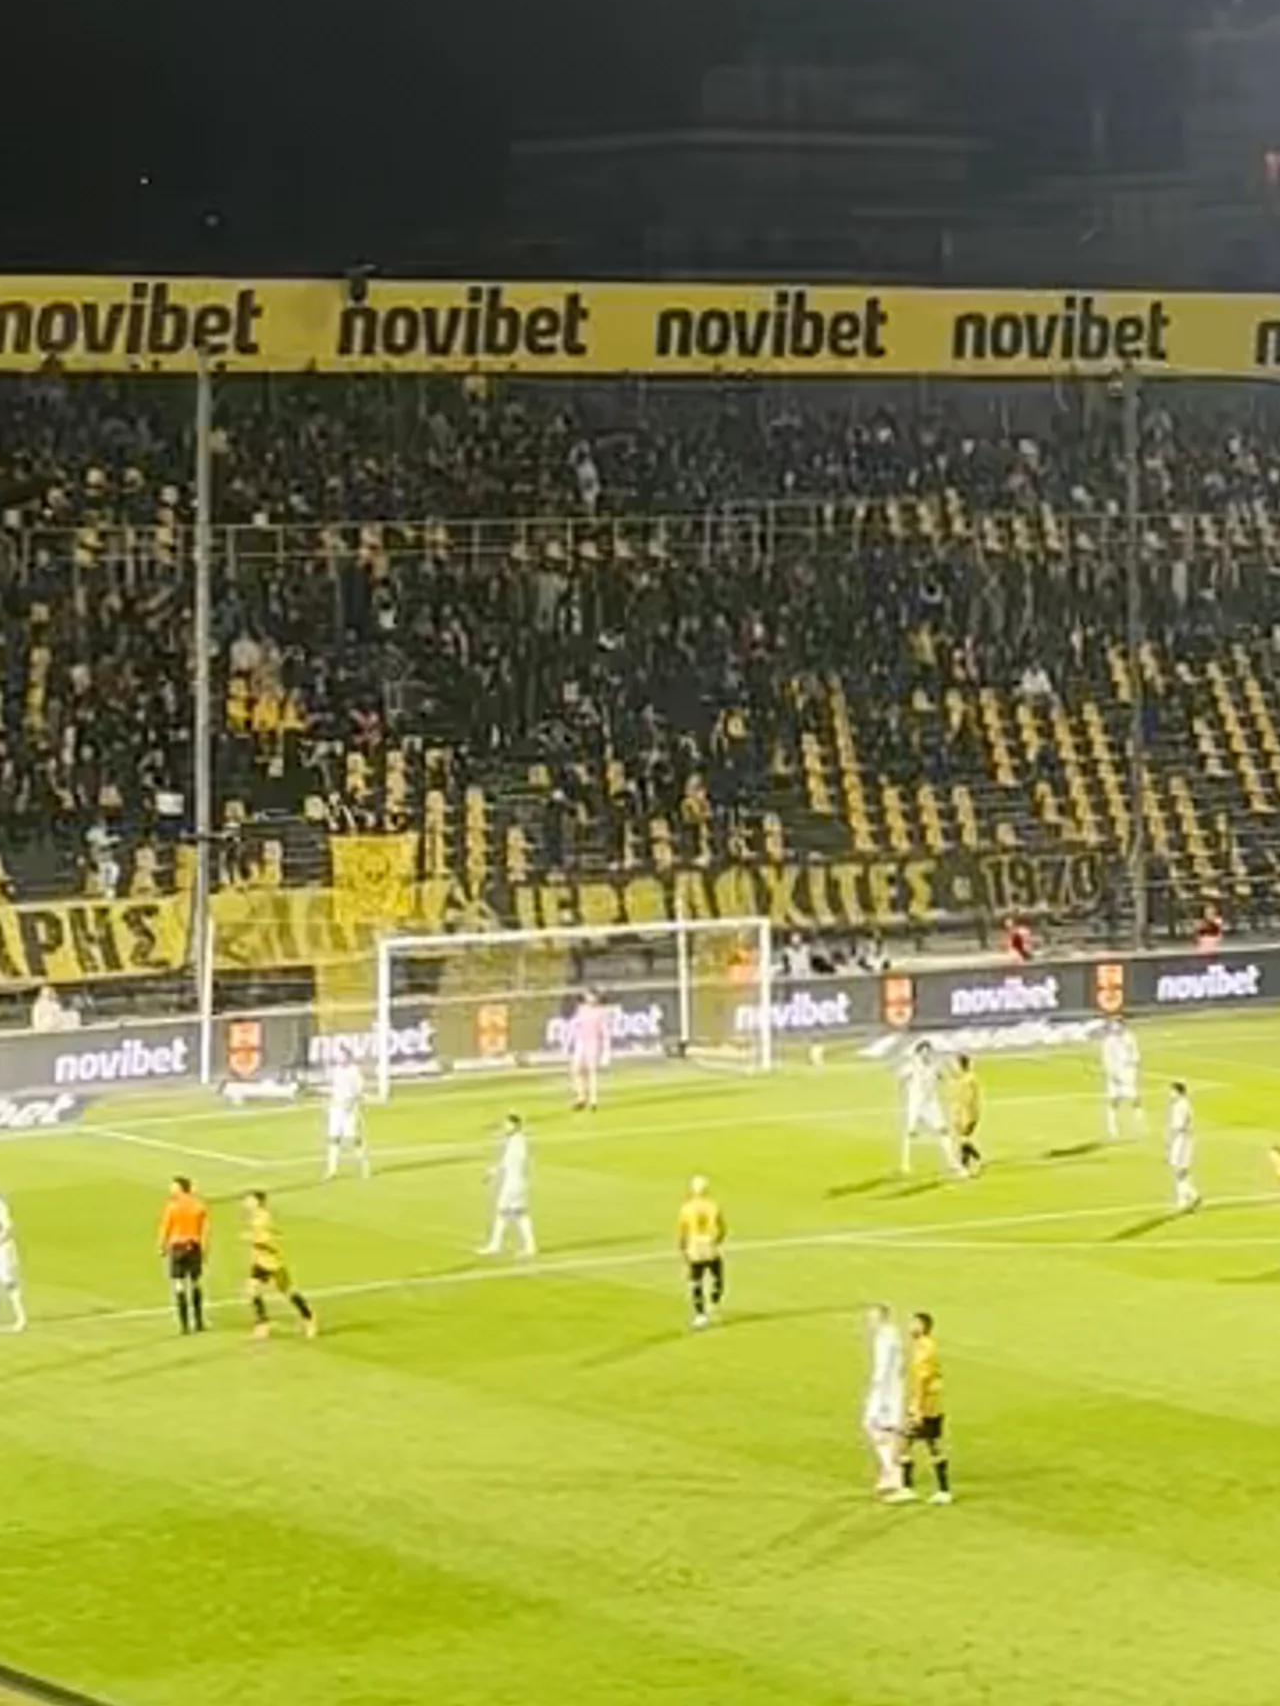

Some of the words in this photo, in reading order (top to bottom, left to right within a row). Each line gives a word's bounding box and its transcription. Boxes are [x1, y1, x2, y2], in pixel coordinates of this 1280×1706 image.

[337, 288, 590, 356] novibet
[655, 292, 888, 360] novibet
[953, 297, 1171, 361] novibet
[54, 1038, 187, 1083] novibet
[545, 1005, 663, 1044] nbet
[951, 977, 1059, 1015] novibet
[1157, 965, 1260, 1001] novibet
